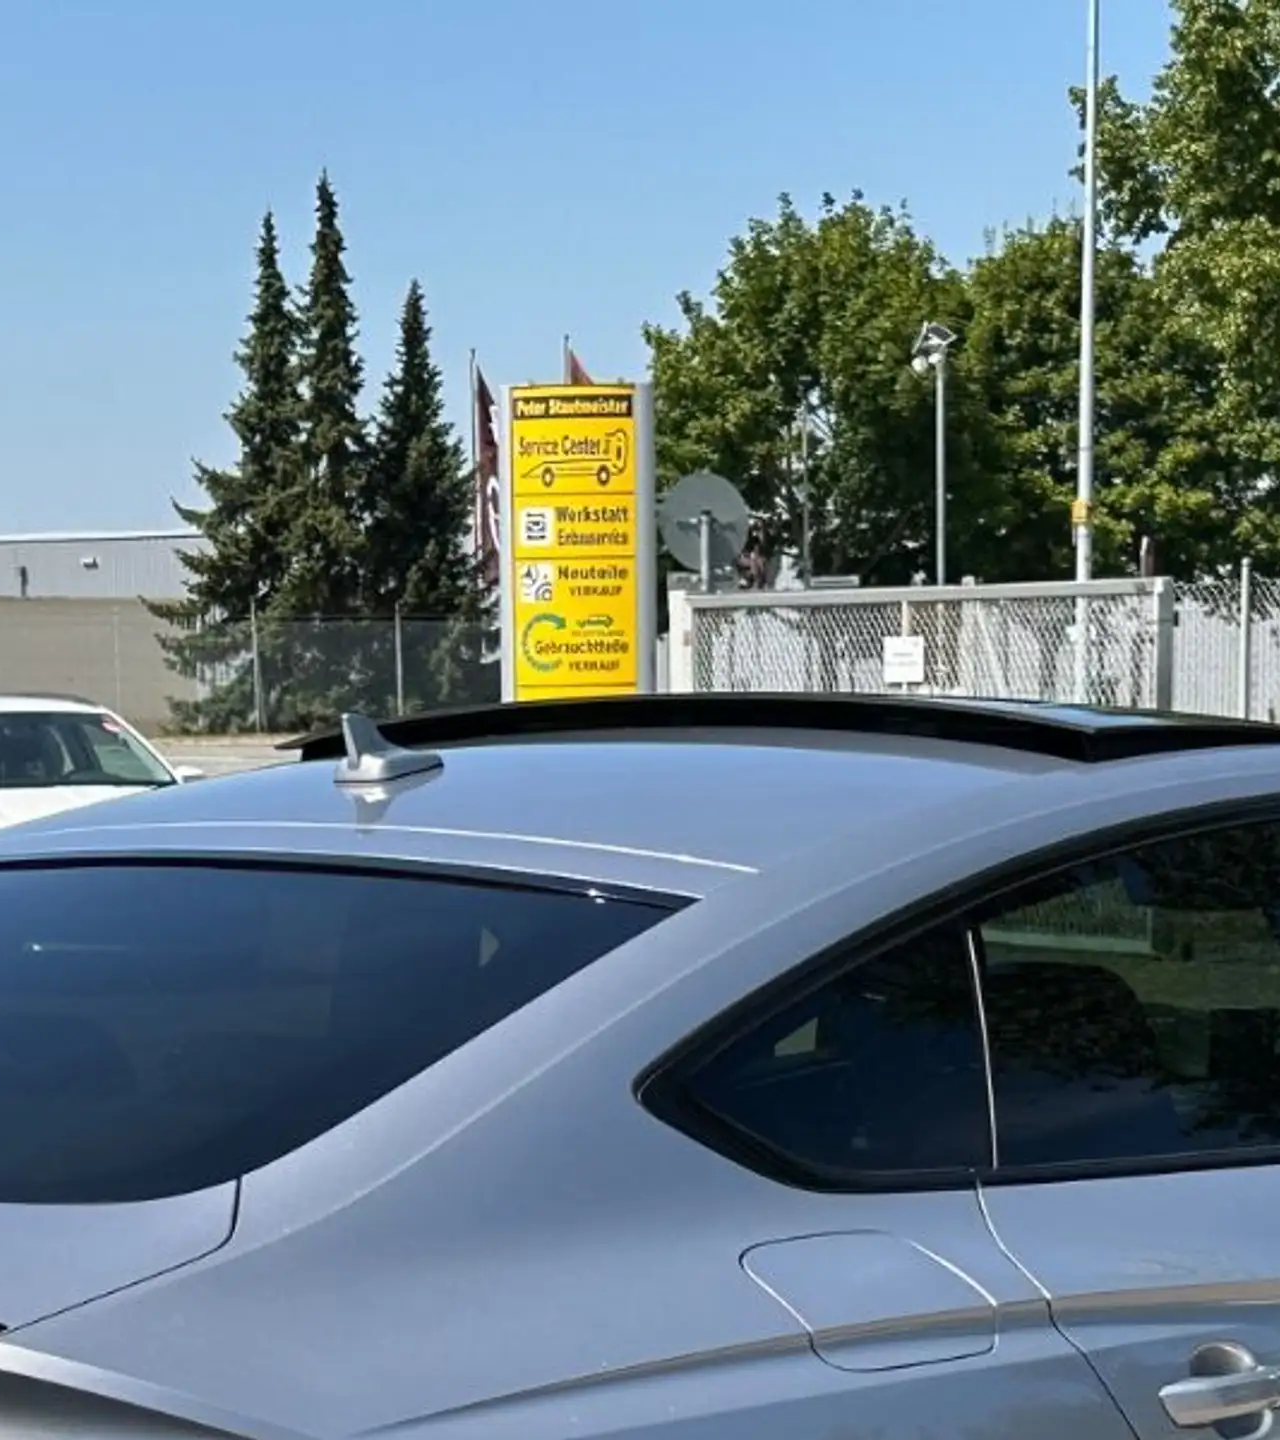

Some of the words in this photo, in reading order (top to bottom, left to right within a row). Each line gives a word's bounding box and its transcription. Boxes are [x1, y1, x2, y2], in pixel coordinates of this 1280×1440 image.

[516, 399, 546, 416] Peter
[519, 435, 559, 457] Service
[561, 434, 601, 456] Center
[555, 505, 629, 522] Werkstatt
[557, 565, 629, 581] Neuteile
[568, 584, 623, 597] VERKAUF
[568, 659, 621, 672] VERKAUF
